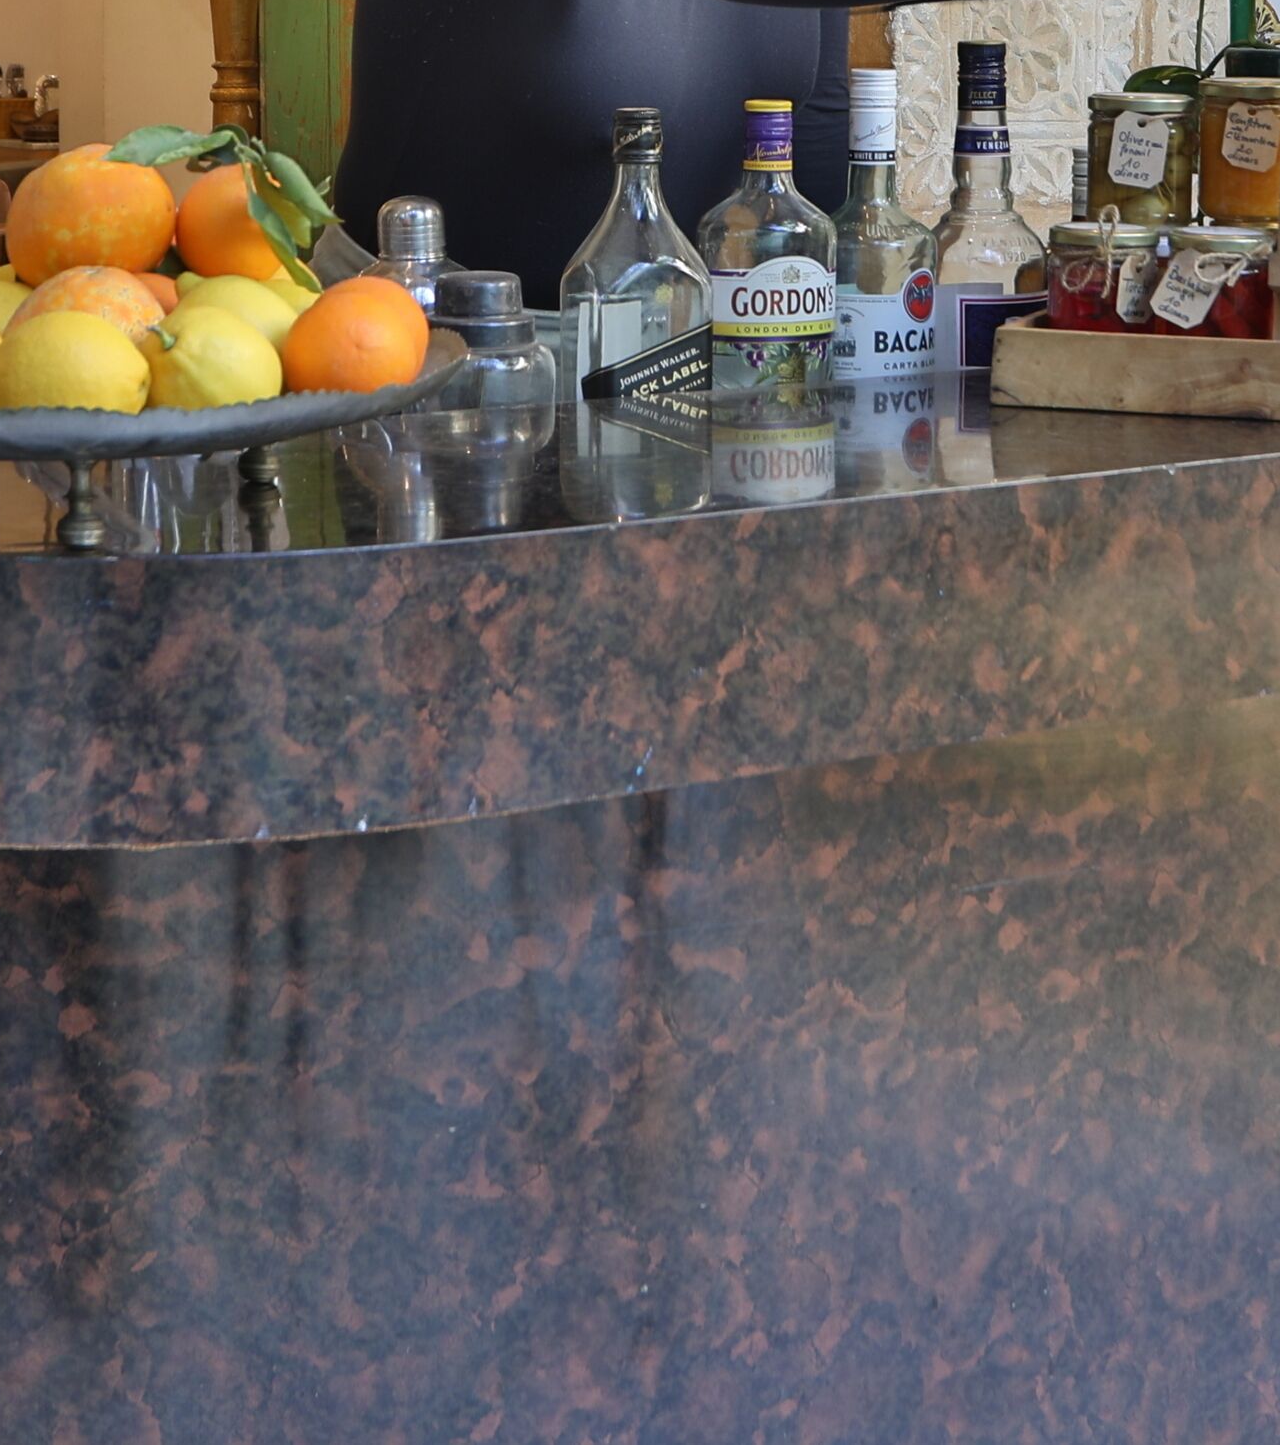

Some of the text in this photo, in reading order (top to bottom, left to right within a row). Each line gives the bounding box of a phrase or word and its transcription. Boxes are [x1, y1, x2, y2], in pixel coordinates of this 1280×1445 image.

[976, 140, 1009, 150] VENEZIA
[1123, 158, 1140, 169] 10
[731, 282, 833, 317] GORDON'S
[874, 327, 935, 353] BACAR
[883, 362, 918, 370] CARTA
[620, 364, 660, 390] JOHNNIE
[632, 379, 659, 398] ACK
